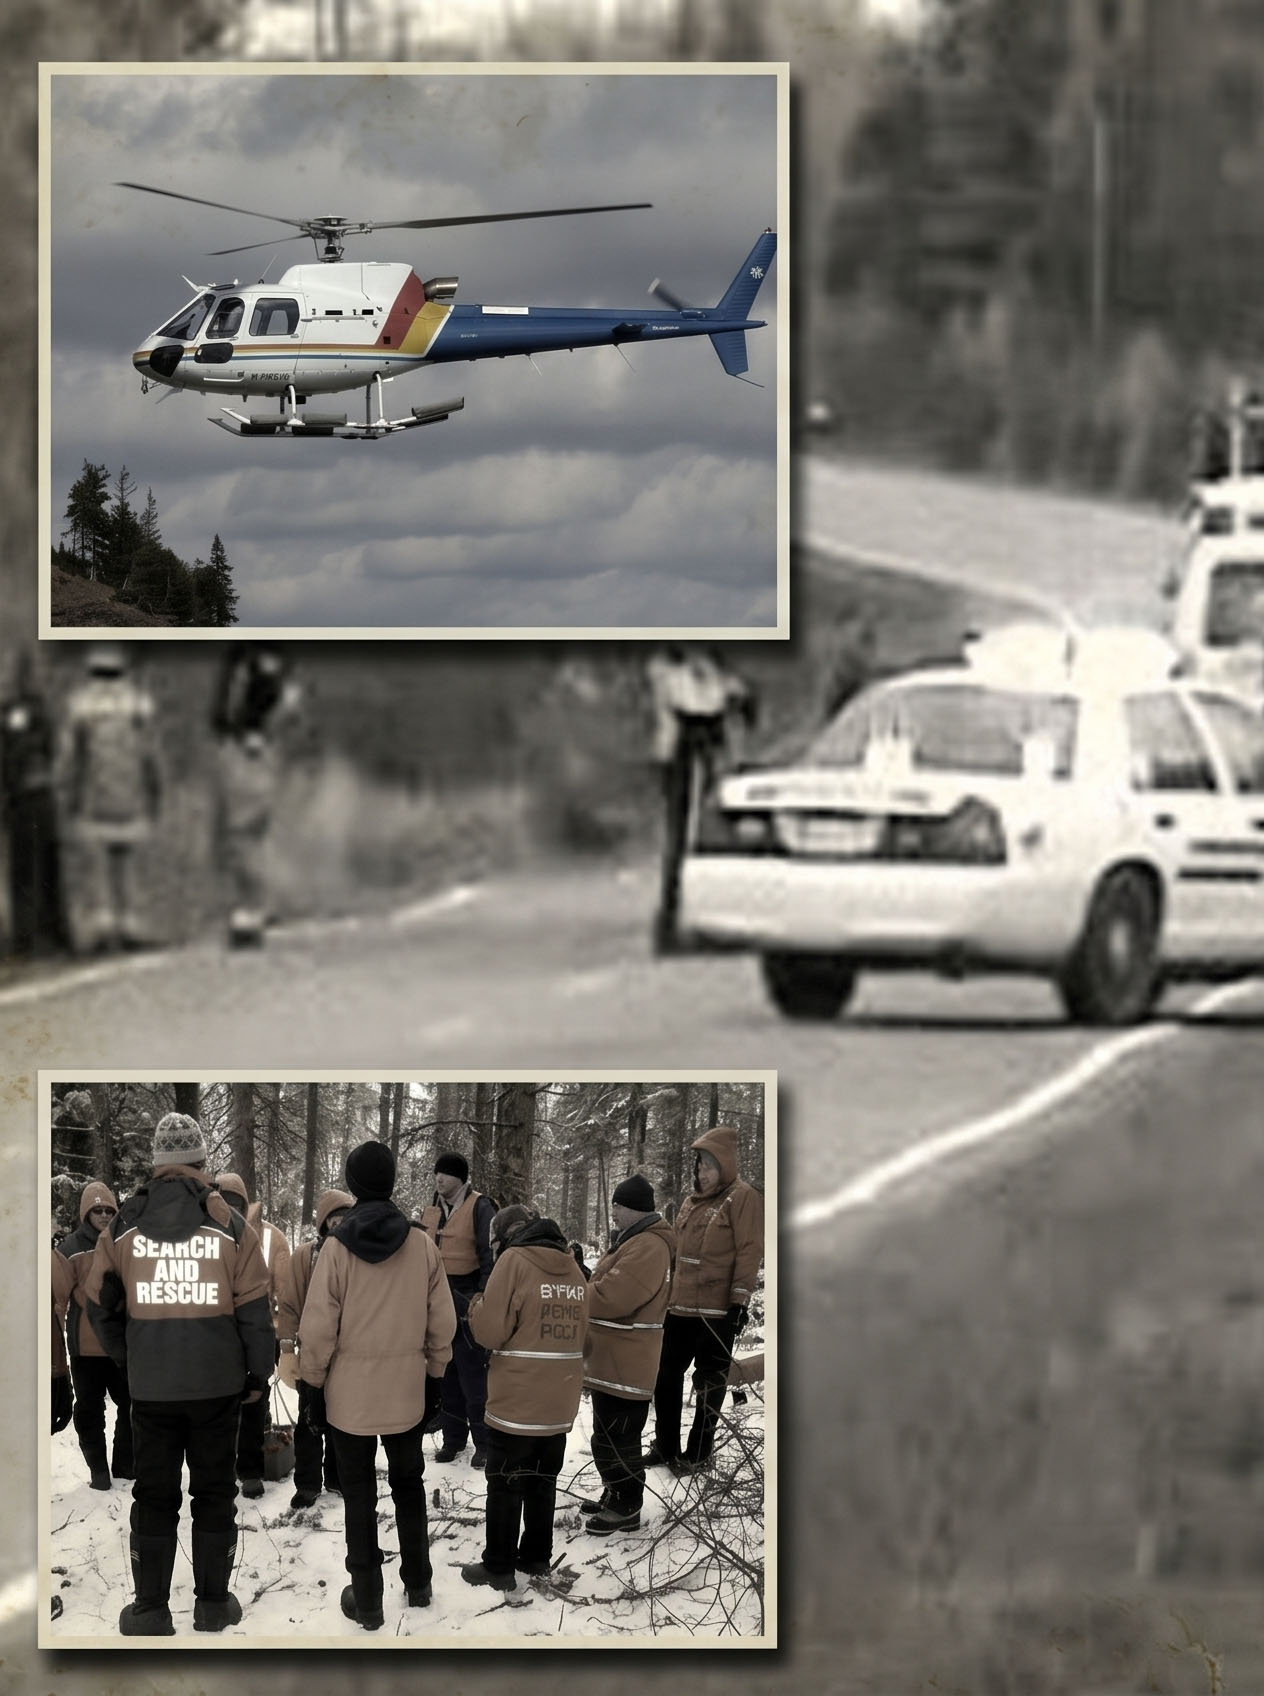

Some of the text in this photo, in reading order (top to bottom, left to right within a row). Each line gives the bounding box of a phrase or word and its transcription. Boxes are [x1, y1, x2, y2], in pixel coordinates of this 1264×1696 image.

[133, 1235, 220, 1259] SEARCH
[154, 1260, 199, 1282] AND
[136, 1282, 219, 1305] RESCUE
